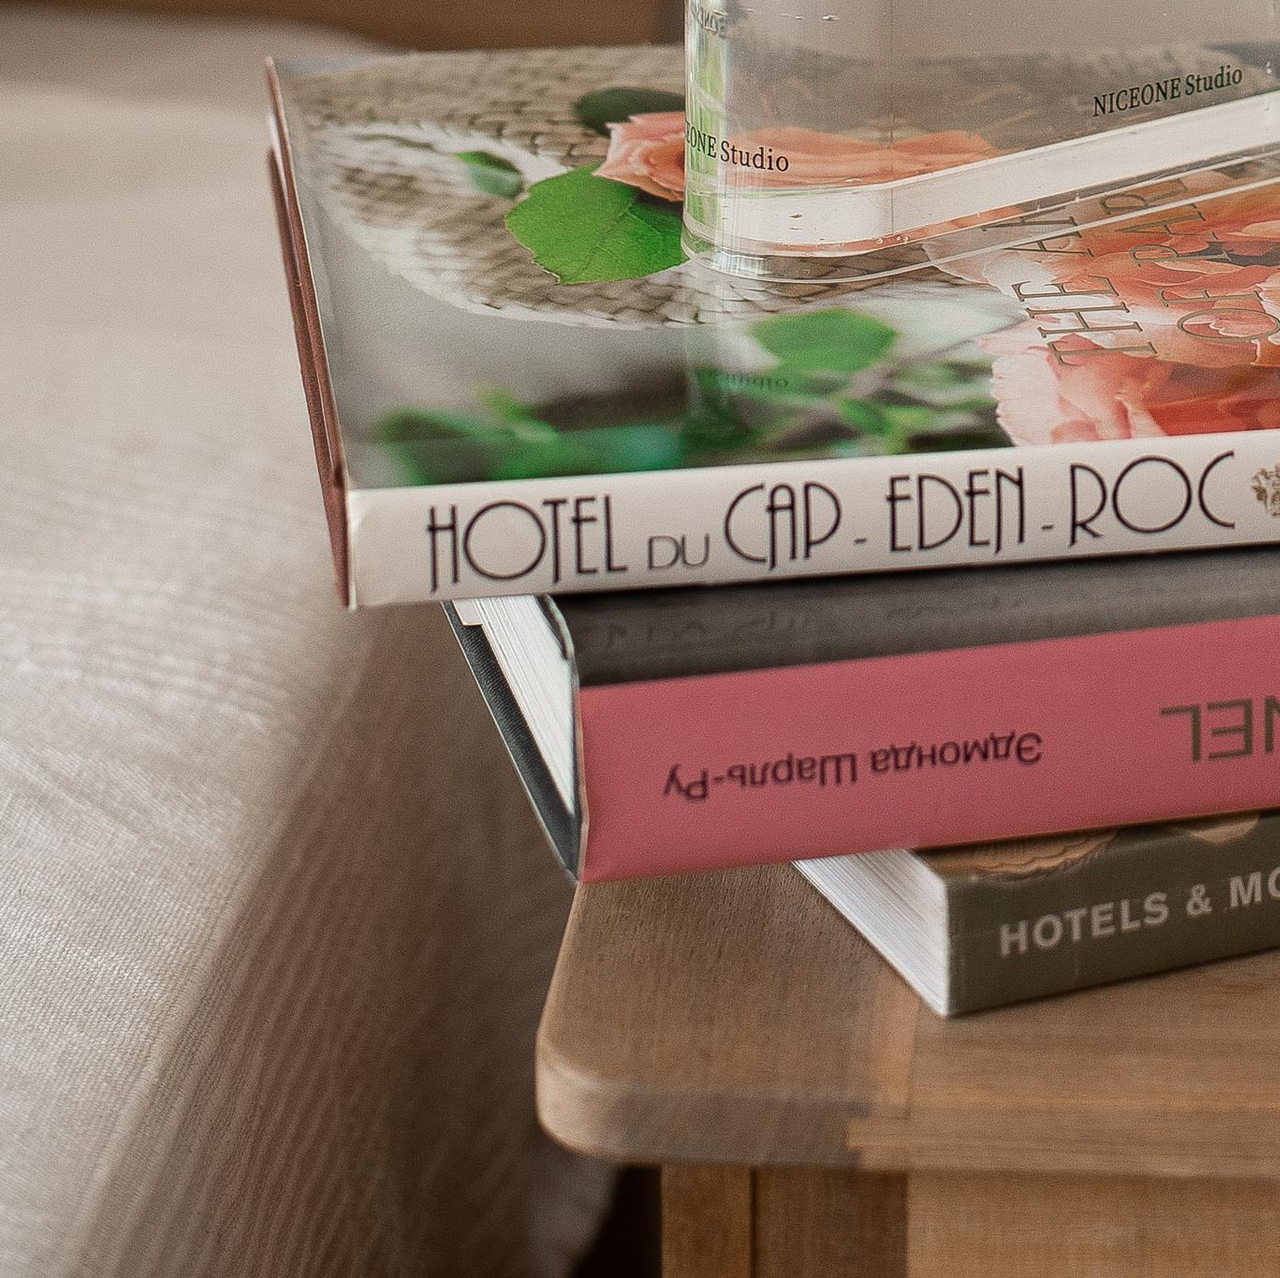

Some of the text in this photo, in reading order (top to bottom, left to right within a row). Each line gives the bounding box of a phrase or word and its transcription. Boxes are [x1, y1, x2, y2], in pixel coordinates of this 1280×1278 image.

[1092, 64, 1243, 117] NICEONE Studio
[720, 140, 789, 172] Studio
[1011, 275, 1157, 366] THE
[427, 494, 628, 594] HOTEL
[647, 533, 710, 570] DU
[723, 480, 843, 572] CAP
[886, 465, 1025, 554] EDEN
[1068, 450, 1236, 547] ROC
[662, 729, 1044, 802] Эдмонда Шарль-Ру
[999, 891, 1170, 957] HOTELS
[1186, 882, 1213, 918] &
